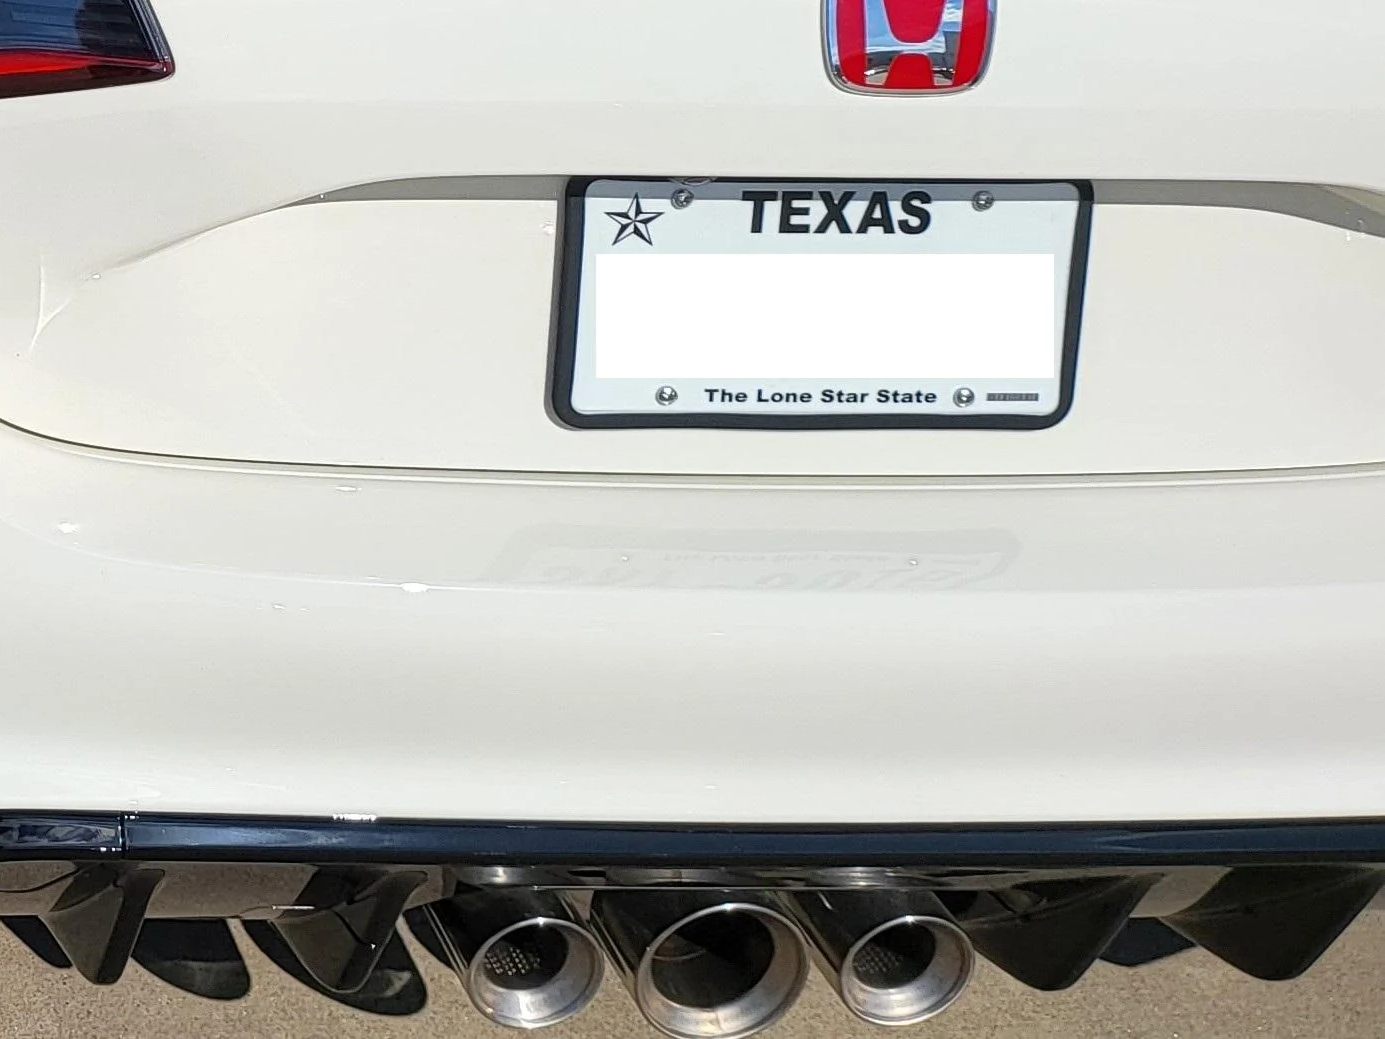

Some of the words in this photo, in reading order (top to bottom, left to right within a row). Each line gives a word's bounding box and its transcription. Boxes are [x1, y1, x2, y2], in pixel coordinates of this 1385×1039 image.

[741, 190, 933, 235] TEXAS
[704, 388, 748, 403] The
[756, 388, 813, 403] Lone
[820, 388, 870, 404] Star
[875, 388, 938, 404] State
